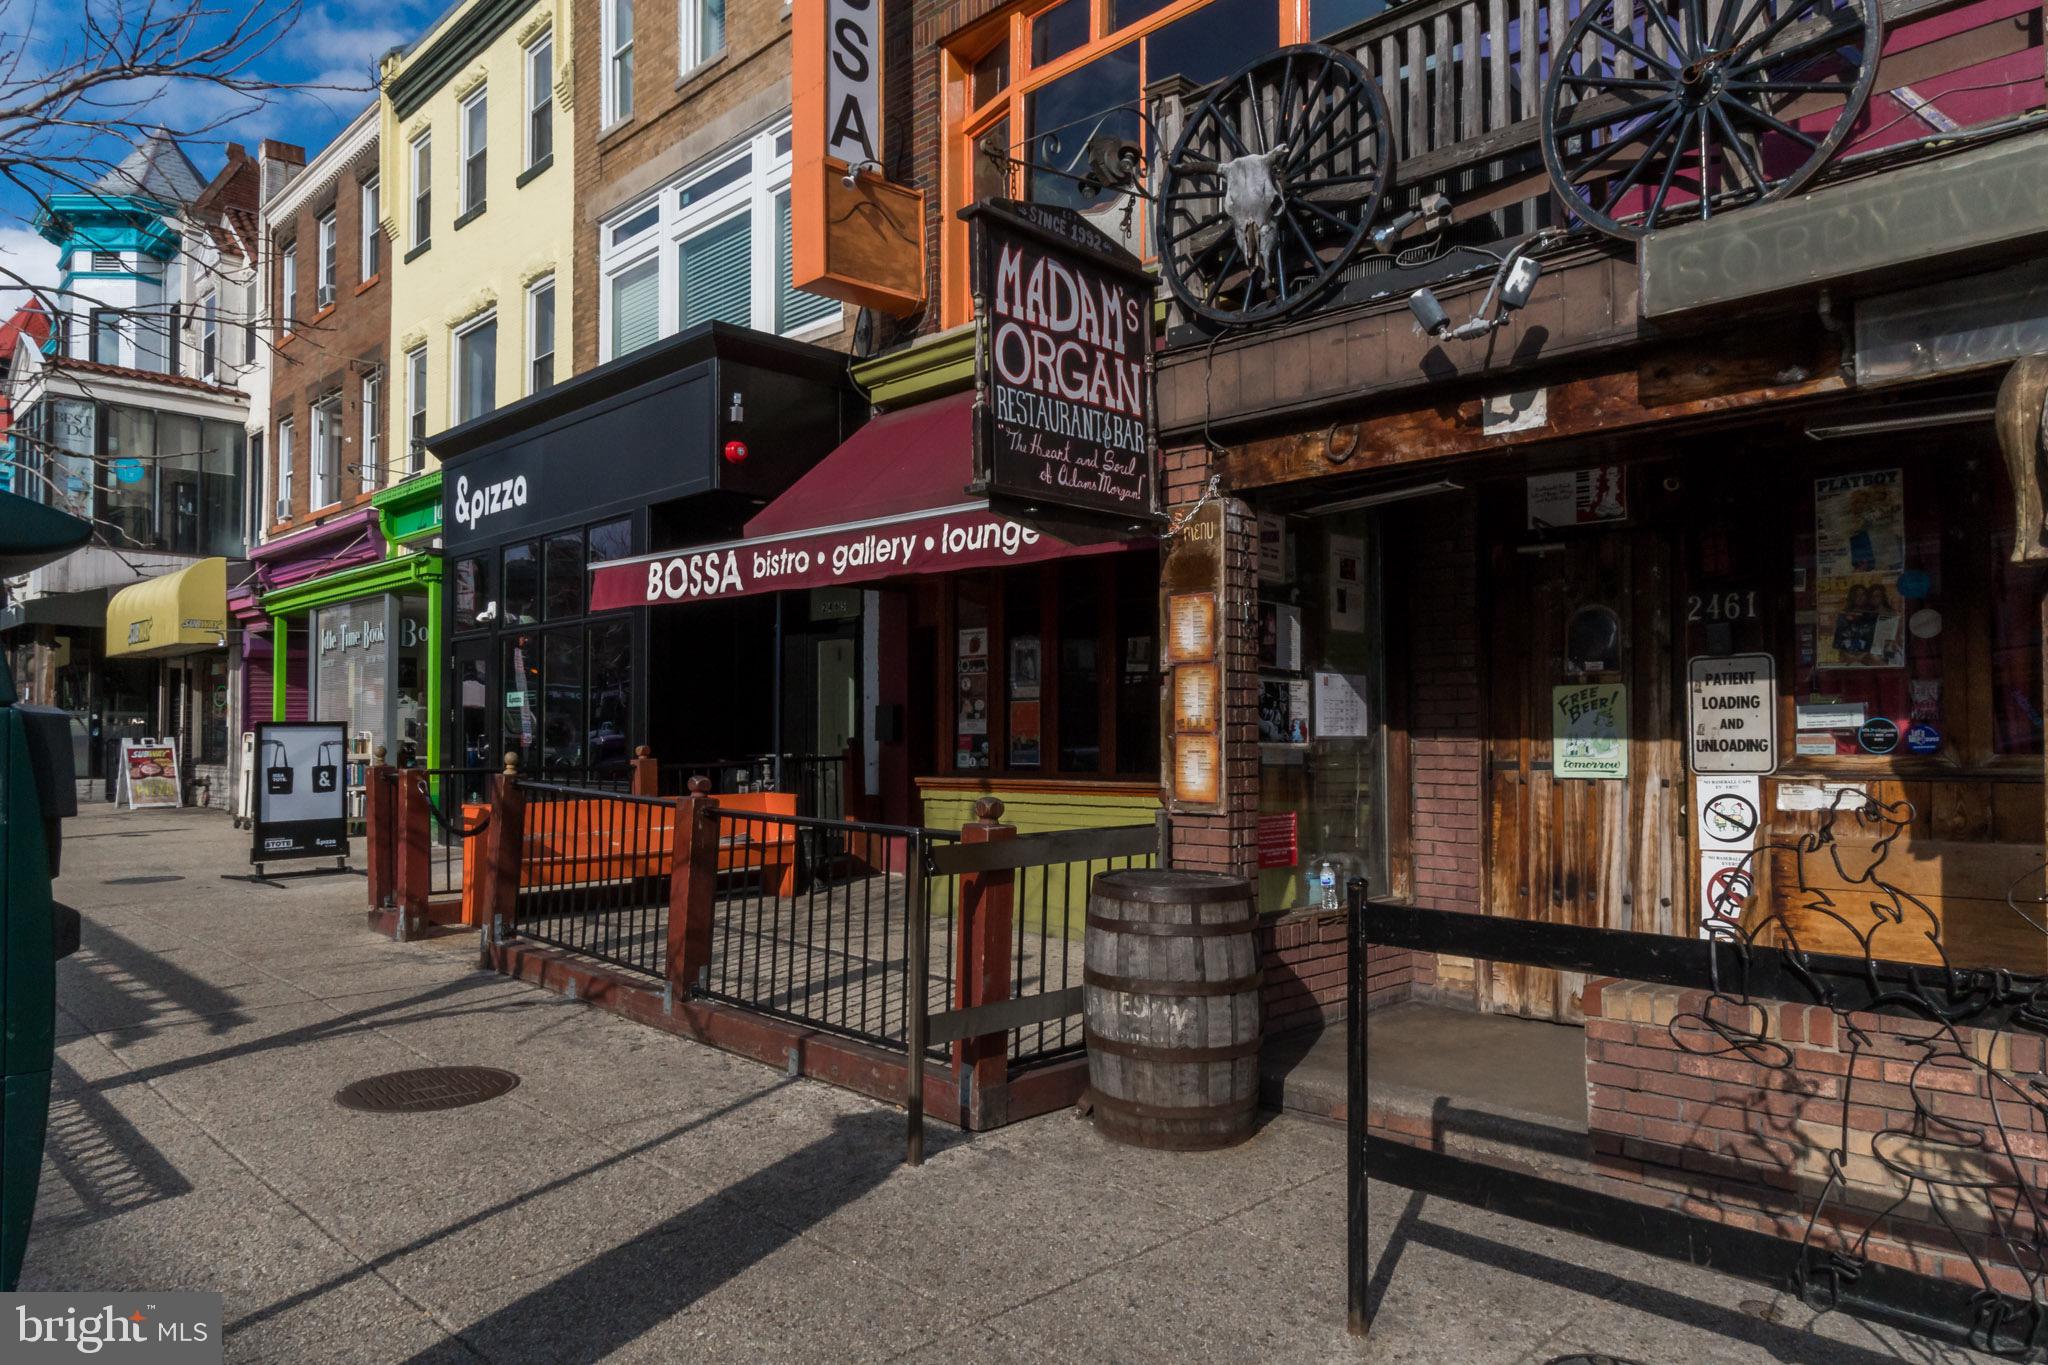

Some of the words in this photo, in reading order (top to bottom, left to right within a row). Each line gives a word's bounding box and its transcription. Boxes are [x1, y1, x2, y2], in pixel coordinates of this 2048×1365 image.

[832, 0, 876, 161] SA
[1029, 206, 1067, 237] SINCE
[1071, 223, 1102, 252] 1992
[996, 241, 1139, 354] MADAM'S
[995, 322, 1142, 417] ORGAN
[1029, 433, 1071, 463] Heart
[1075, 449, 1099, 469] and
[1102, 450, 1136, 477] Soul
[1039, 462, 1053, 485] of
[1057, 464, 1097, 491] Adams
[1817, 471, 1899, 492] PLAYBOY
[455, 475, 528, 530] &pizza
[646, 550, 744, 601] BOSSA
[753, 548, 810, 579] bistro
[832, 535, 917, 576] gallery
[942, 521, 1040, 556] lounge
[1688, 591, 1758, 621] 2461
[321, 628, 337, 656] Idle
[340, 623, 361, 652] Time
[1705, 672, 1756, 686] PATIENT
[1558, 686, 1599, 716] FREE
[1568, 691, 1619, 725] BEER!
[1702, 695, 1761, 710] LOADING
[1719, 718, 1744, 730] AND
[1696, 739, 1769, 753] UNLOADING
[1563, 760, 1620, 769] tomorrow
